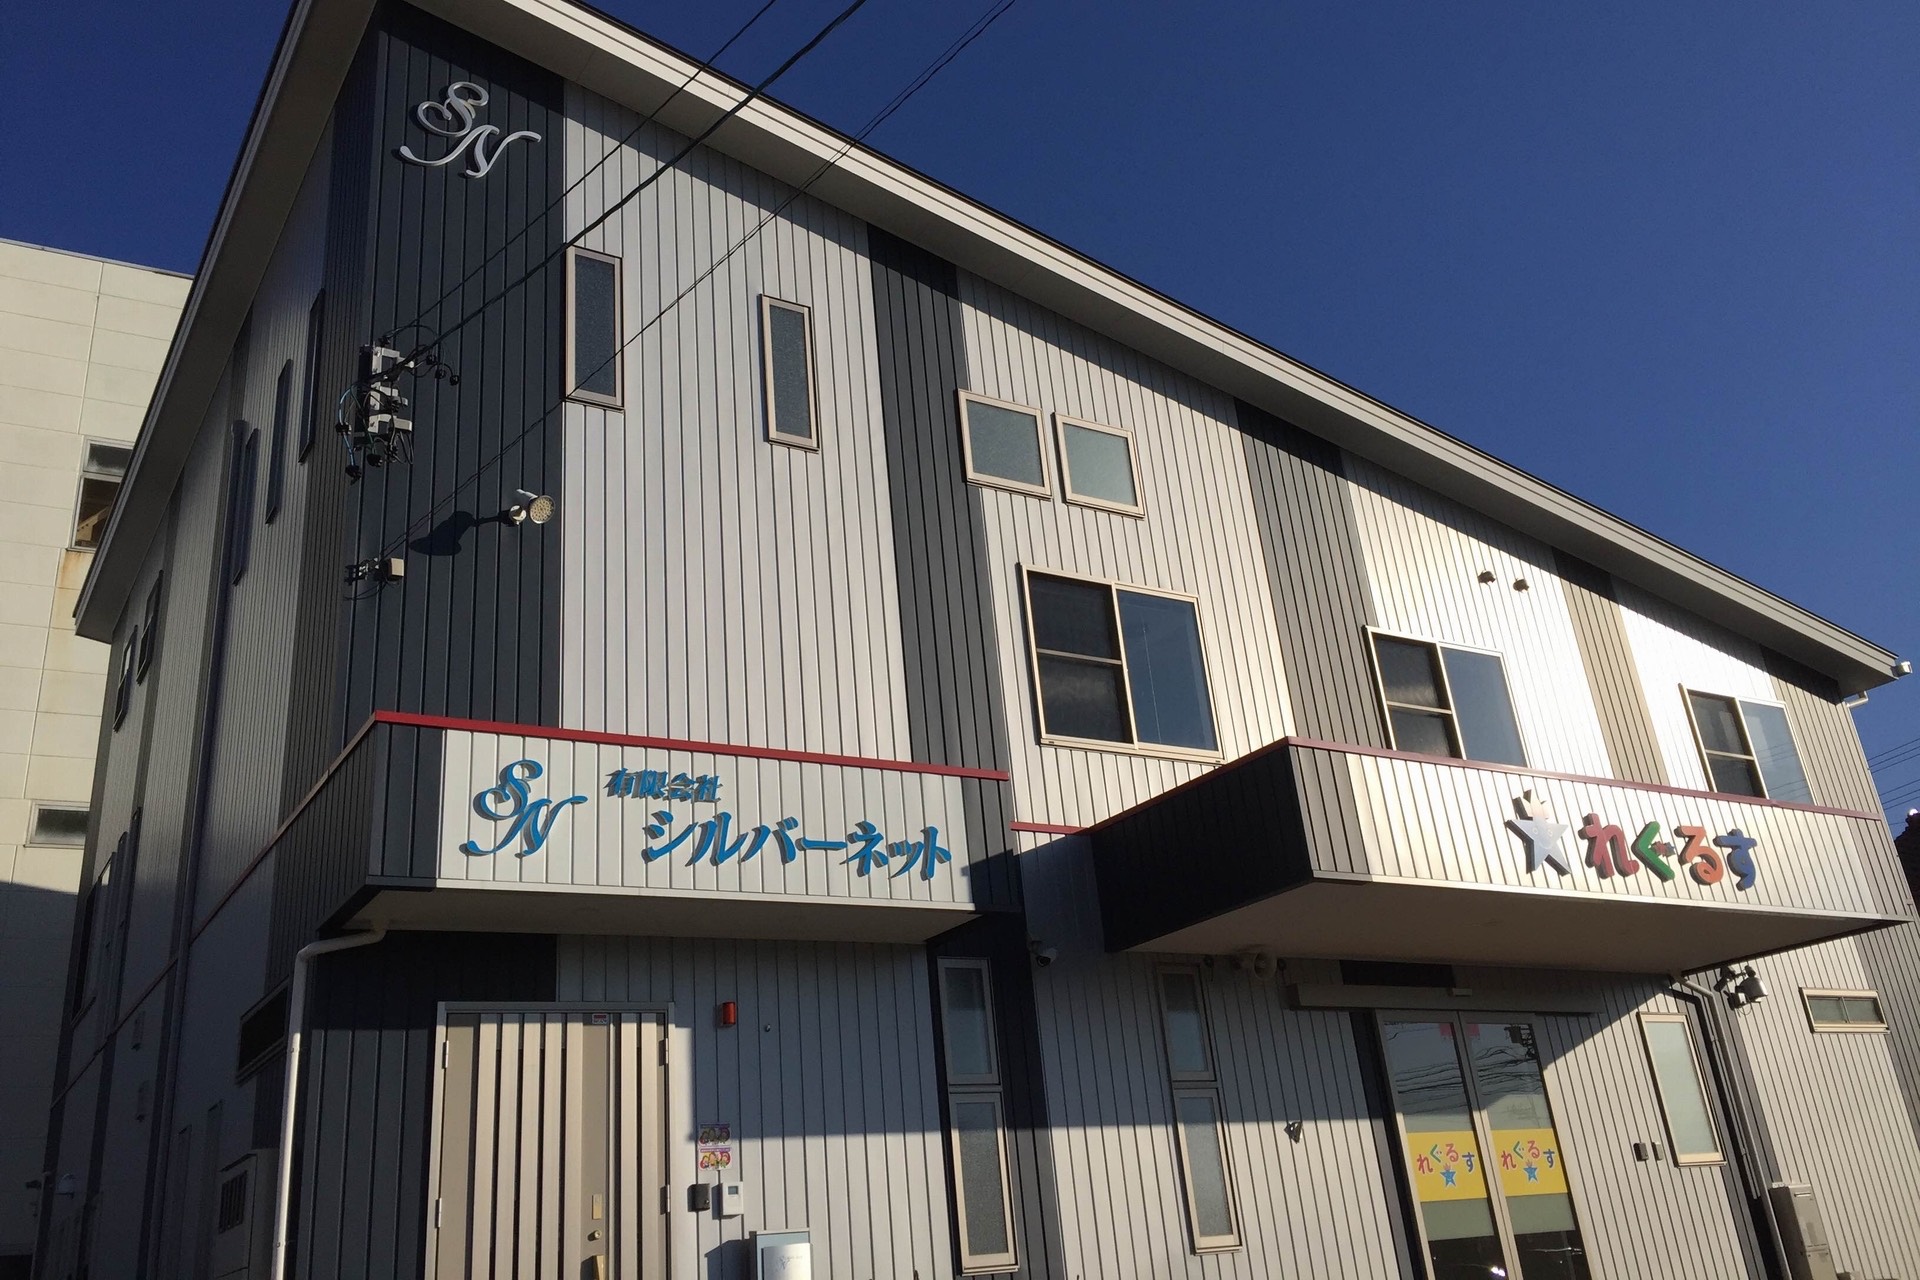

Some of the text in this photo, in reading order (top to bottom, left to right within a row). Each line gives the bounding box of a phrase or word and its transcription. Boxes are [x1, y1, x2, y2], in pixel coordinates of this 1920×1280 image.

[605, 768, 722, 803] 有限会社
[642, 811, 952, 881] シルバーネット
[1579, 813, 1758, 891] れぐるす
[1417, 1143, 1475, 1175] れぐるす
[1501, 1140, 1556, 1171] れぐるす
